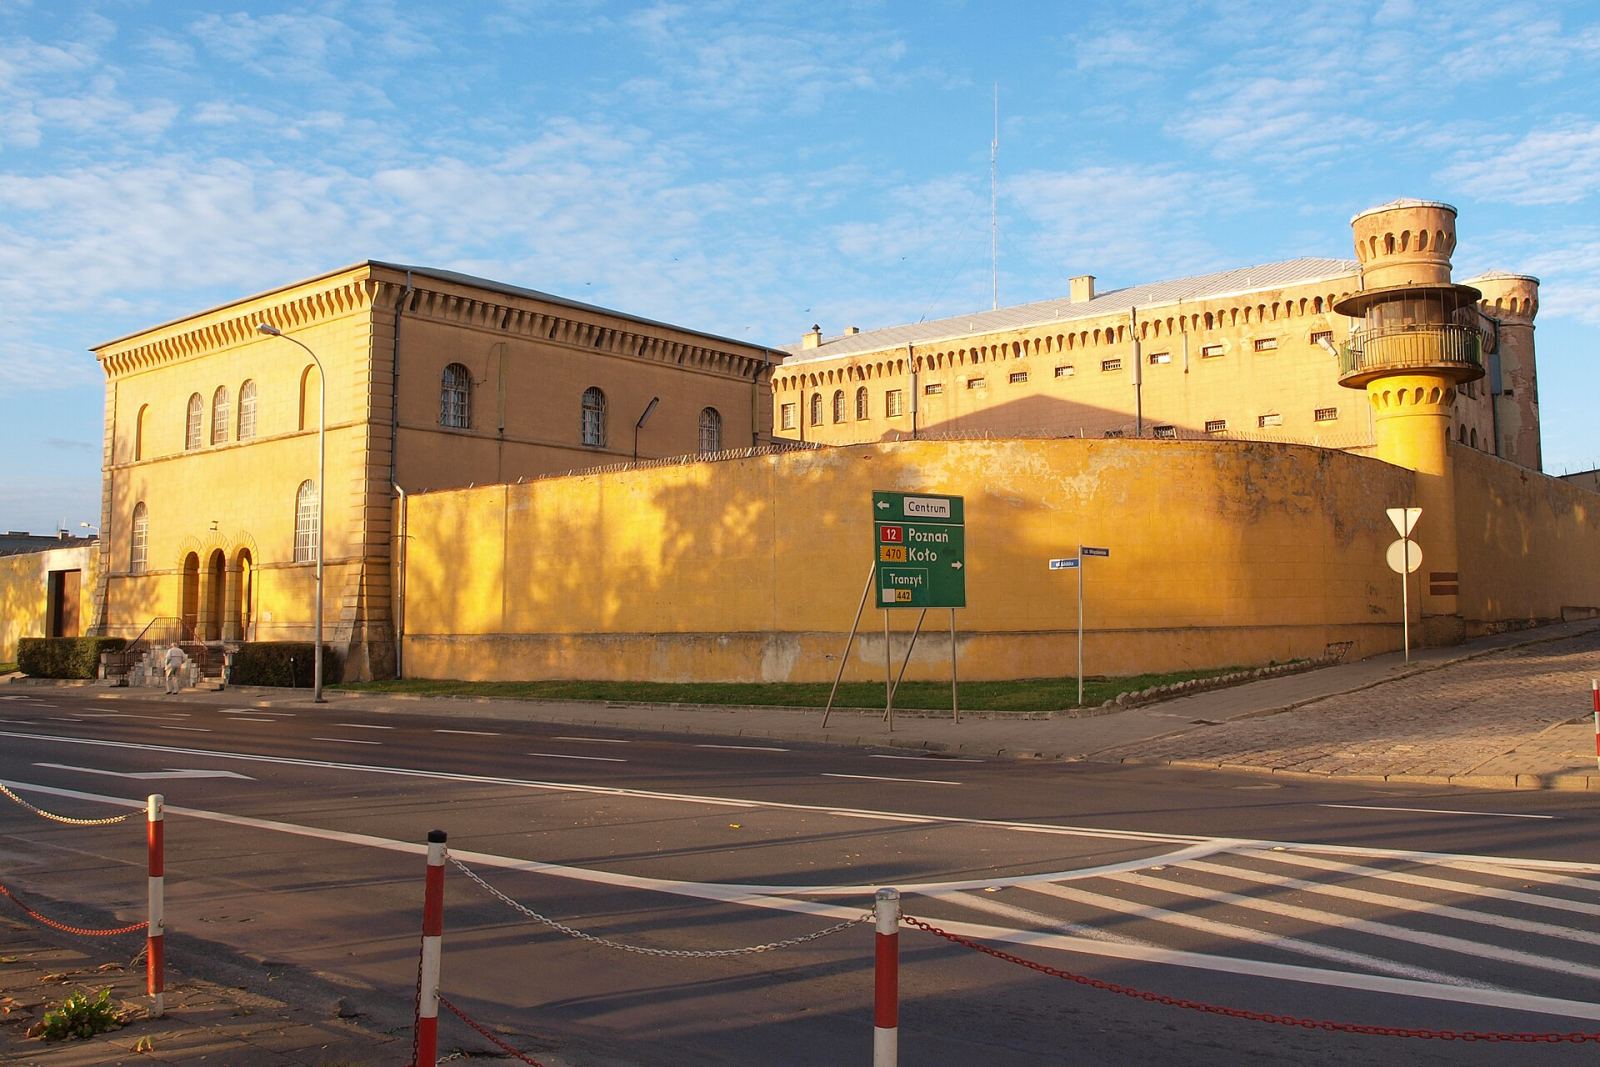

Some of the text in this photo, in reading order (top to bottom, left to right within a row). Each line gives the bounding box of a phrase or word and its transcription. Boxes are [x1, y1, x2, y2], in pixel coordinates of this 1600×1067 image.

[908, 501, 946, 513] Centrum
[886, 528, 949, 542] 12 Poznań
[885, 548, 937, 561] 470 Koło
[889, 573, 922, 587] Tranzyt
[896, 592, 911, 600] 442
